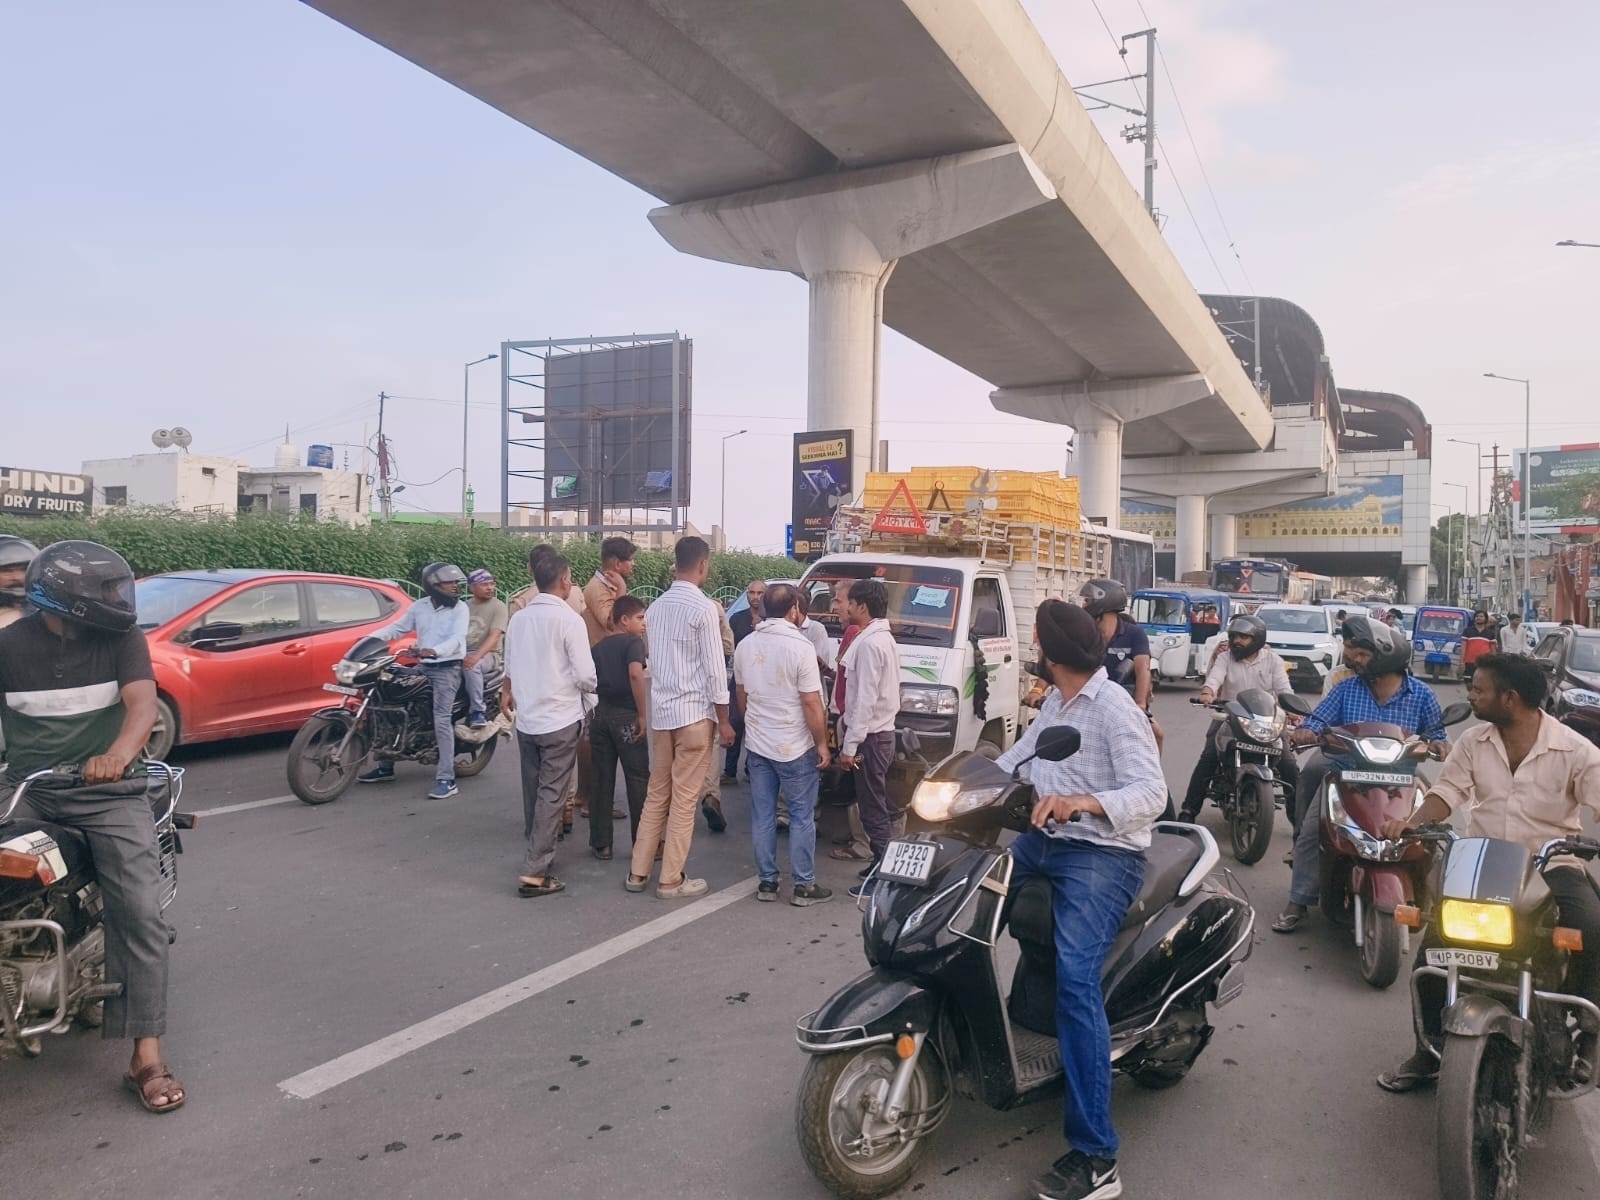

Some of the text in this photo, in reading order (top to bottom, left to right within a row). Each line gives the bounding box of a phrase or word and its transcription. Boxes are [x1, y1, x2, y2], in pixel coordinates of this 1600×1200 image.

[0, 469, 84, 495] HIND
[4, 494, 84, 513] DRY FRUITS
